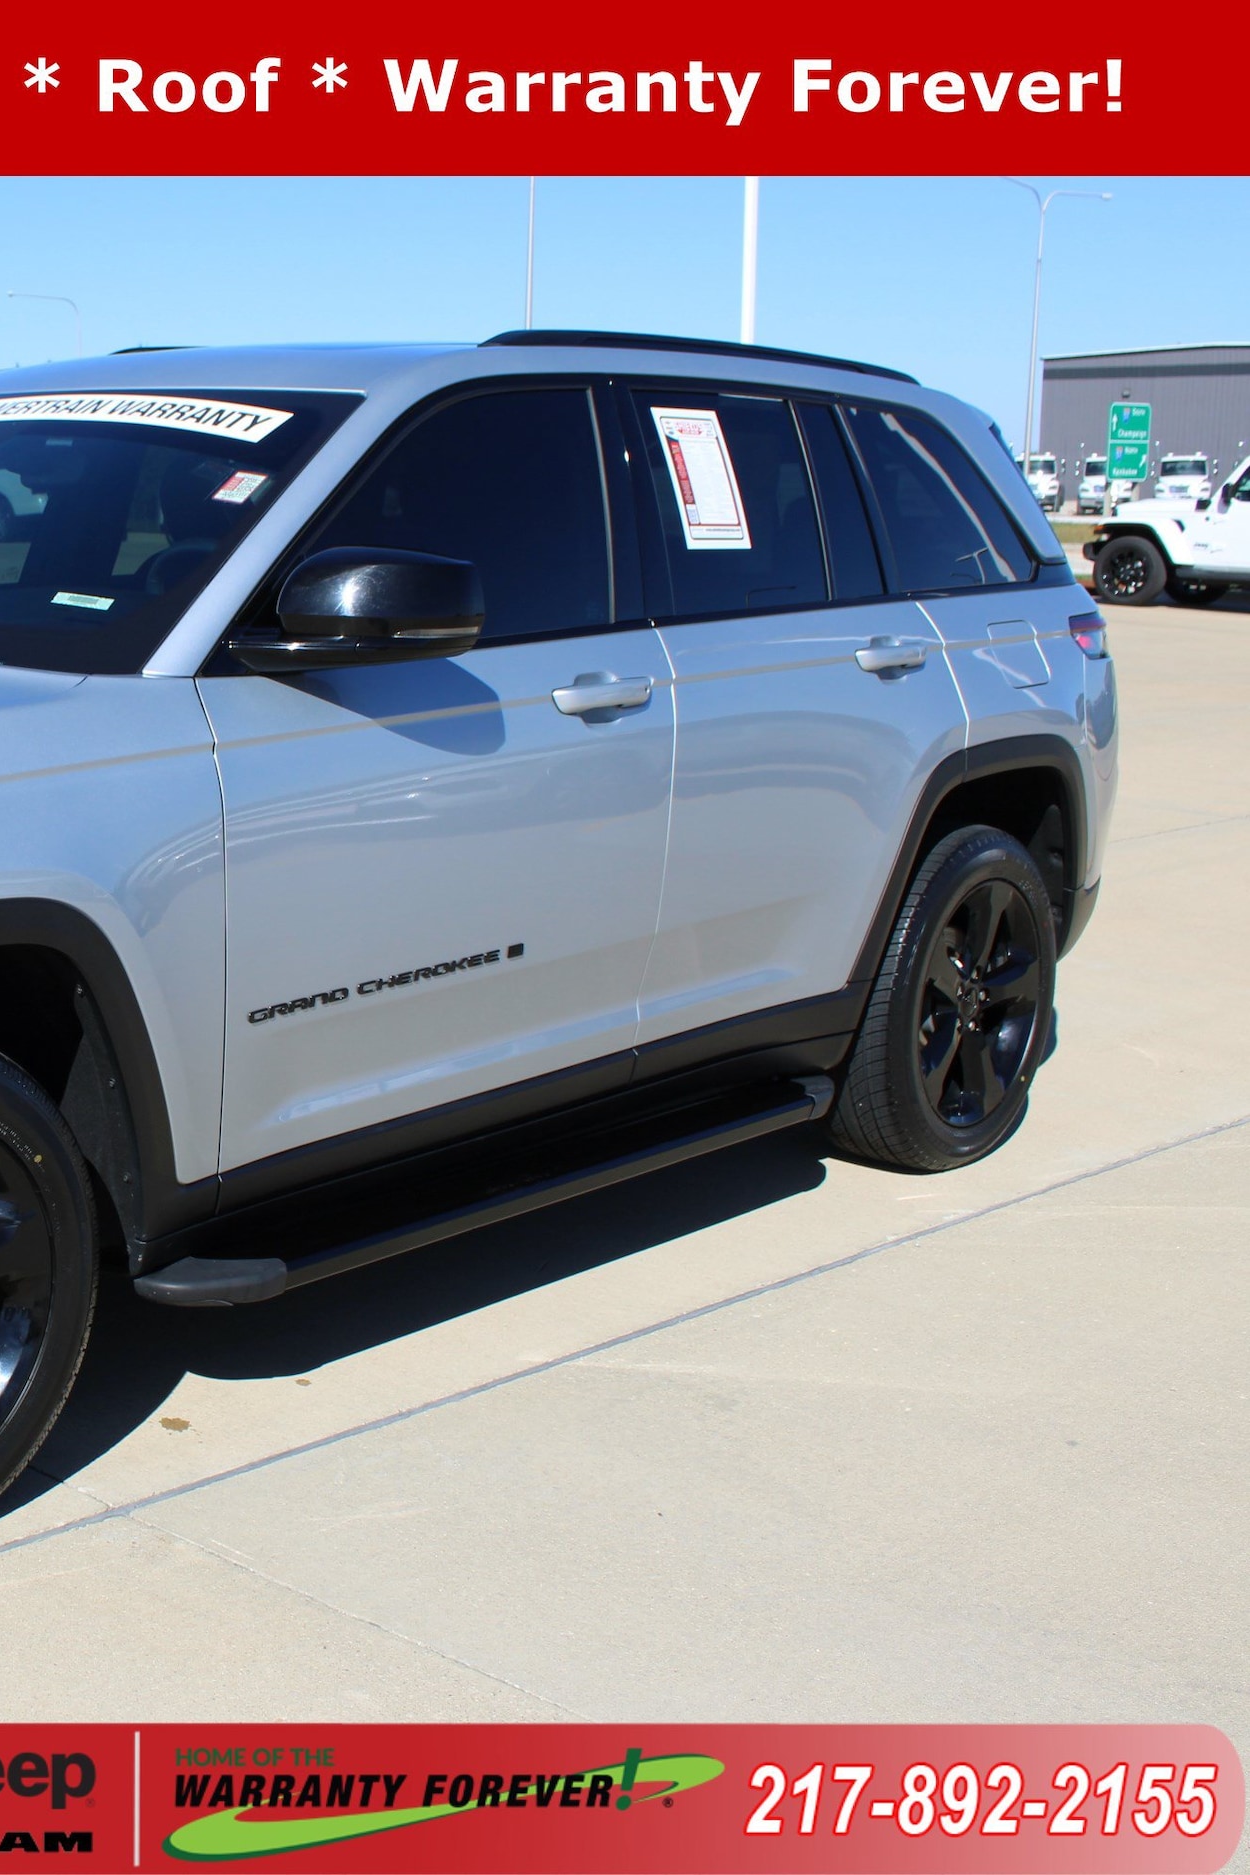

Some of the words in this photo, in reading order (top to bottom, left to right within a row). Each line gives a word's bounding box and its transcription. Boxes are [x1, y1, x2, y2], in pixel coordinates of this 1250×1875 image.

[107, 398, 272, 432] WARRANTY
[247, 987, 350, 1024] GRAND
[356, 949, 502, 996] CHEROKEE
